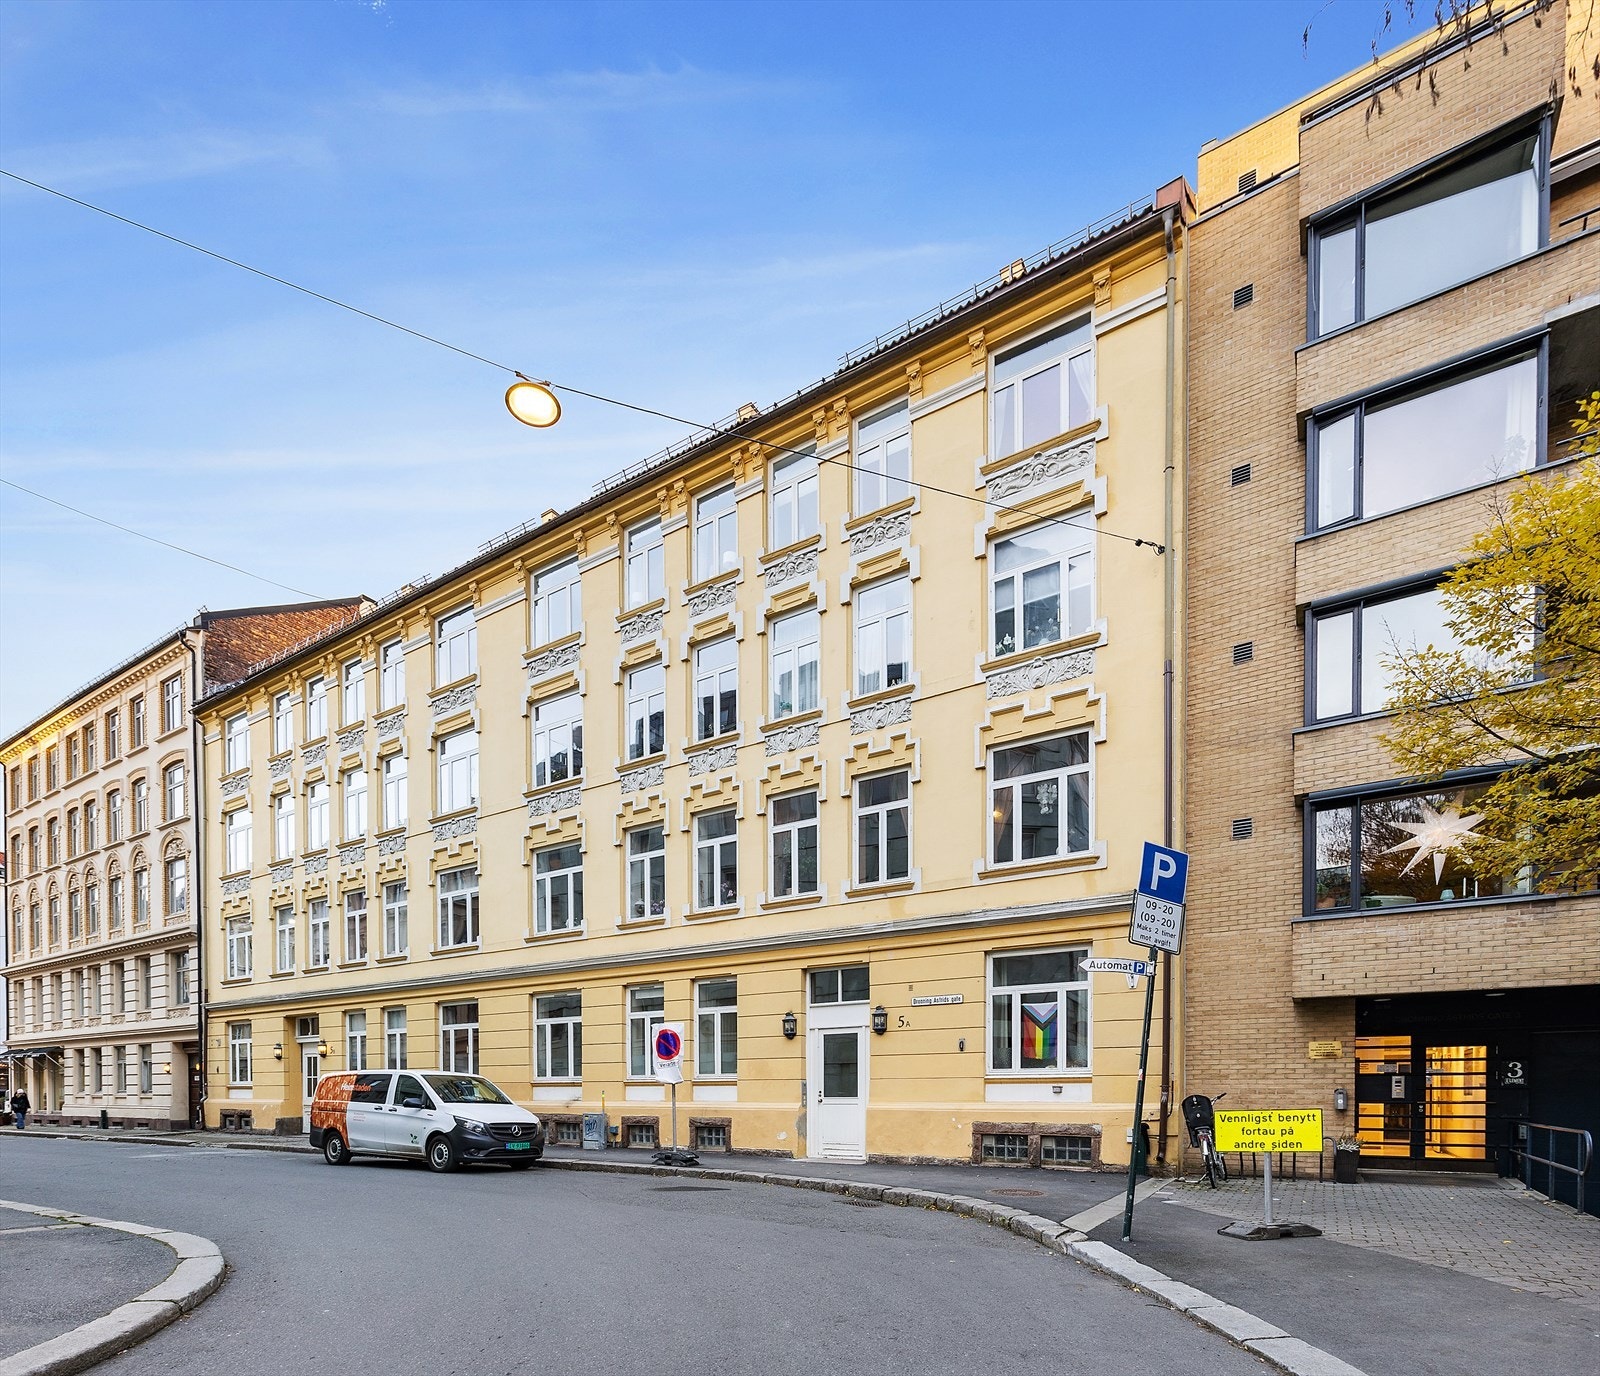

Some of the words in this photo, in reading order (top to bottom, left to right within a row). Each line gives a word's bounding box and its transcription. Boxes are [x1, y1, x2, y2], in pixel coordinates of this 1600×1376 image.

[1150, 851, 1177, 891] P
[1145, 900, 1174, 915] 09-20
[1140, 911, 1176, 930] (09-20)
[1136, 922, 1152, 933] Maks
[1154, 927, 1159, 935] 2
[1161, 929, 1177, 939] timer
[1139, 933, 1152, 941] mot
[1154, 935, 1172, 947] avgift
[1088, 960, 1133, 971] Automat
[1507, 1061, 1523, 1078] 3
[1219, 1113, 1273, 1124] Vennligst
[1277, 1113, 1317, 1124] benytt
[1241, 1127, 1276, 1136] fortau
[1280, 1126, 1294, 1137] på
[1233, 1140, 1266, 1149] andre
[1271, 1139, 1303, 1149] siden
